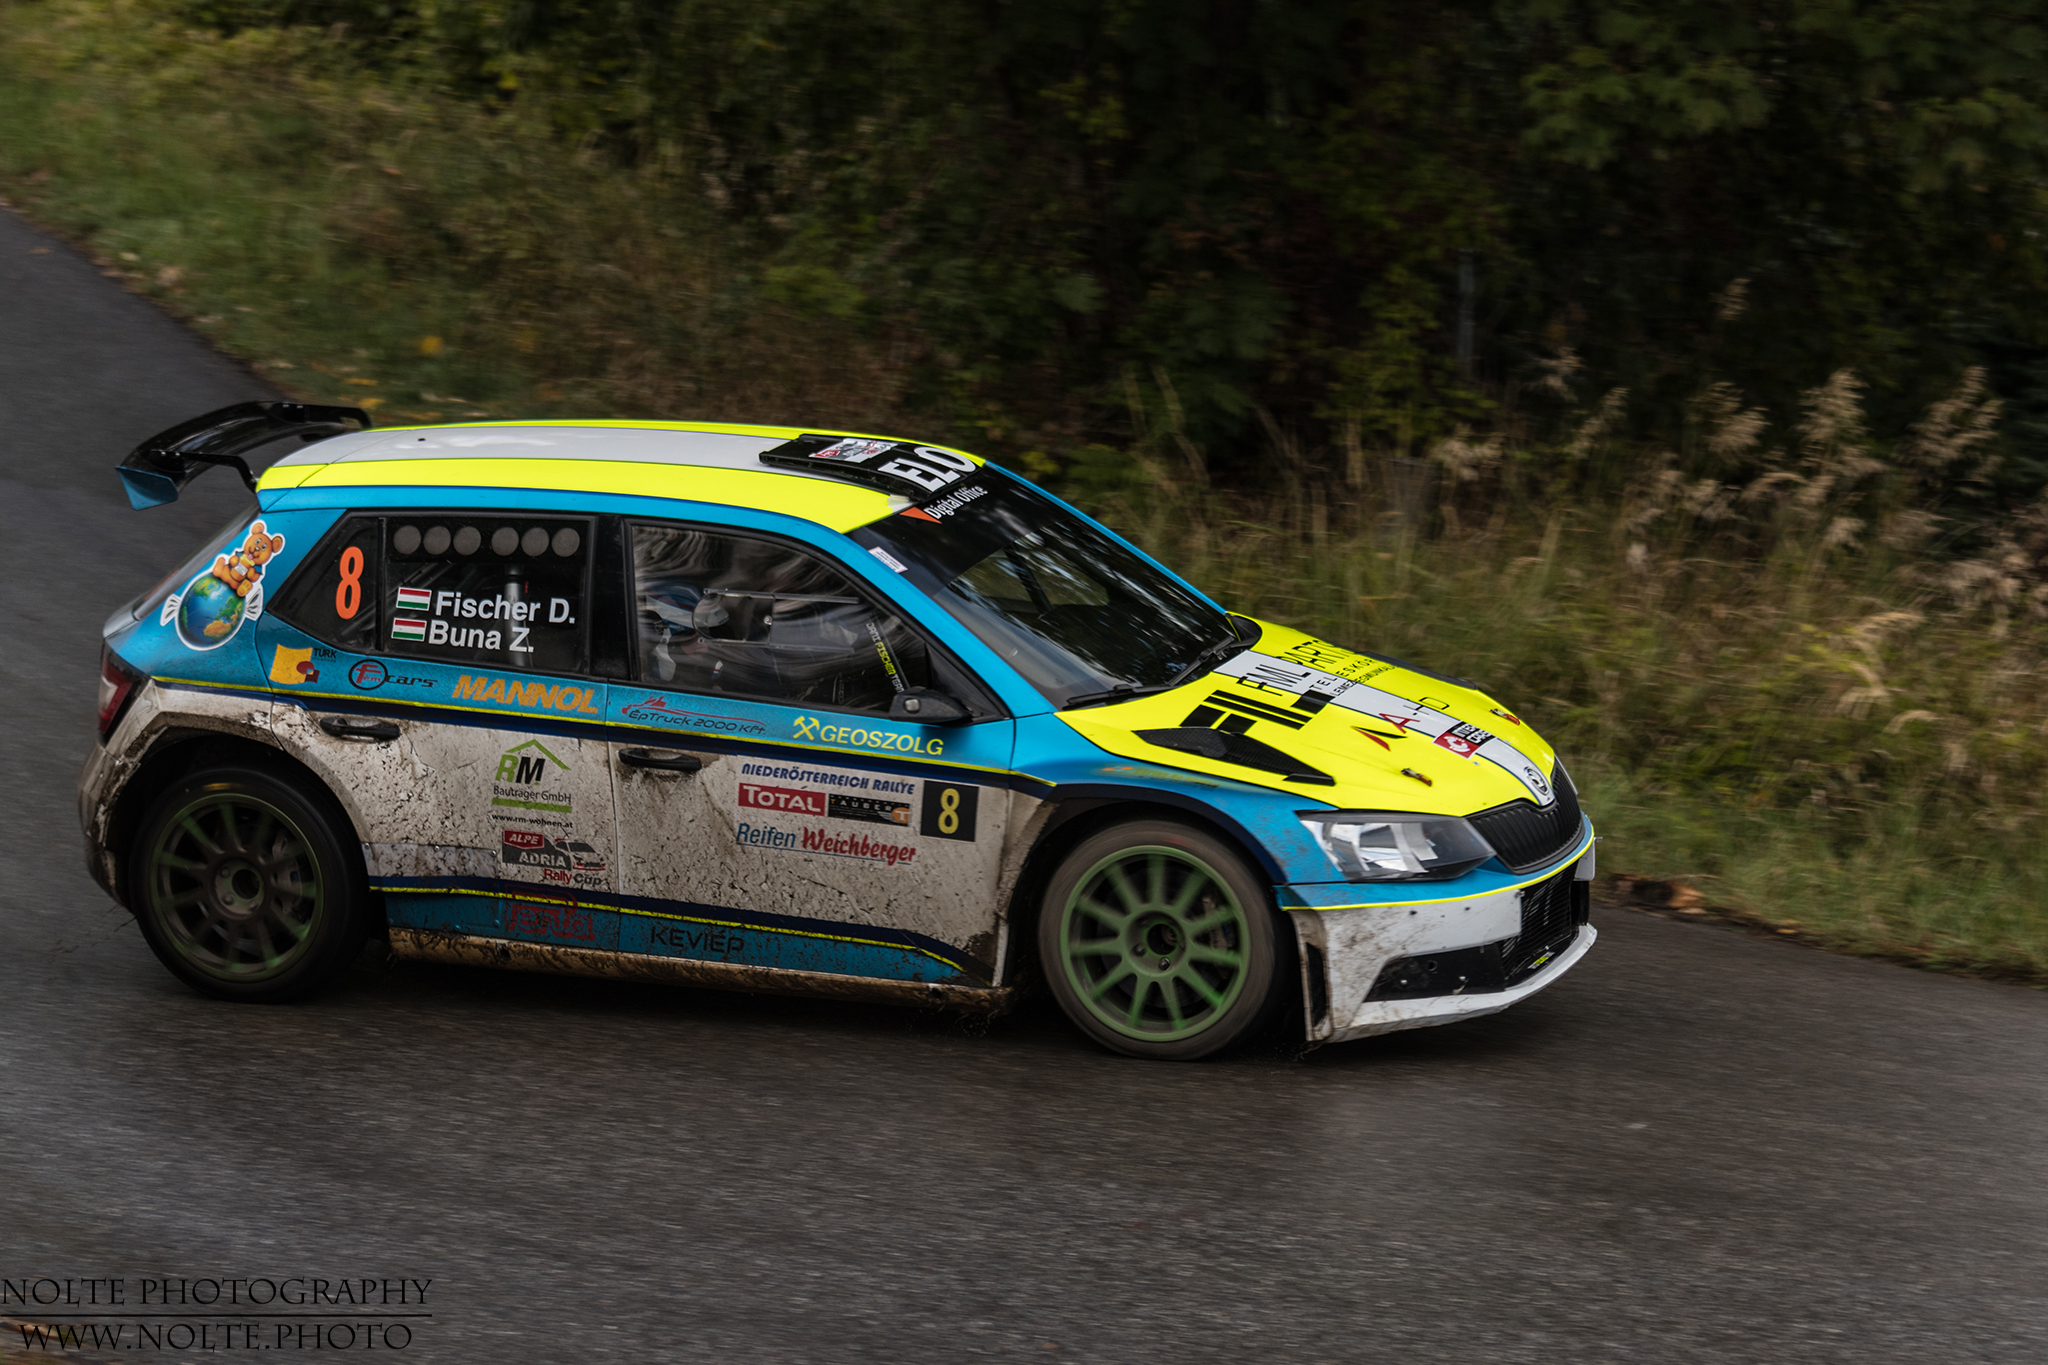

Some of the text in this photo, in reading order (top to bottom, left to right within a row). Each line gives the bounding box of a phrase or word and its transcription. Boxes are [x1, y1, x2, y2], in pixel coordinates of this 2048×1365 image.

[923, 485, 989, 520] Digital Office
[335, 546, 364, 619] 8
[435, 591, 576, 624] Fischer D.
[428, 619, 534, 653] Buna Z.
[452, 674, 599, 714] MANNOL
[693, 718, 737, 731] 2000
[820, 725, 944, 755] GEOSZOLG
[495, 754, 546, 784] RM
[741, 763, 915, 795] NIEDERÖSTERREICH RALLYE
[541, 791, 572, 803] GmbH
[743, 785, 821, 812] TOTAL
[830, 799, 892, 811] TAUBER
[938, 788, 960, 834] 8
[509, 834, 539, 845] ALPE
[736, 823, 916, 866] Reifen Weichberger
[519, 852, 567, 867] ADRIA
[544, 869, 602, 886] Rally Cup
